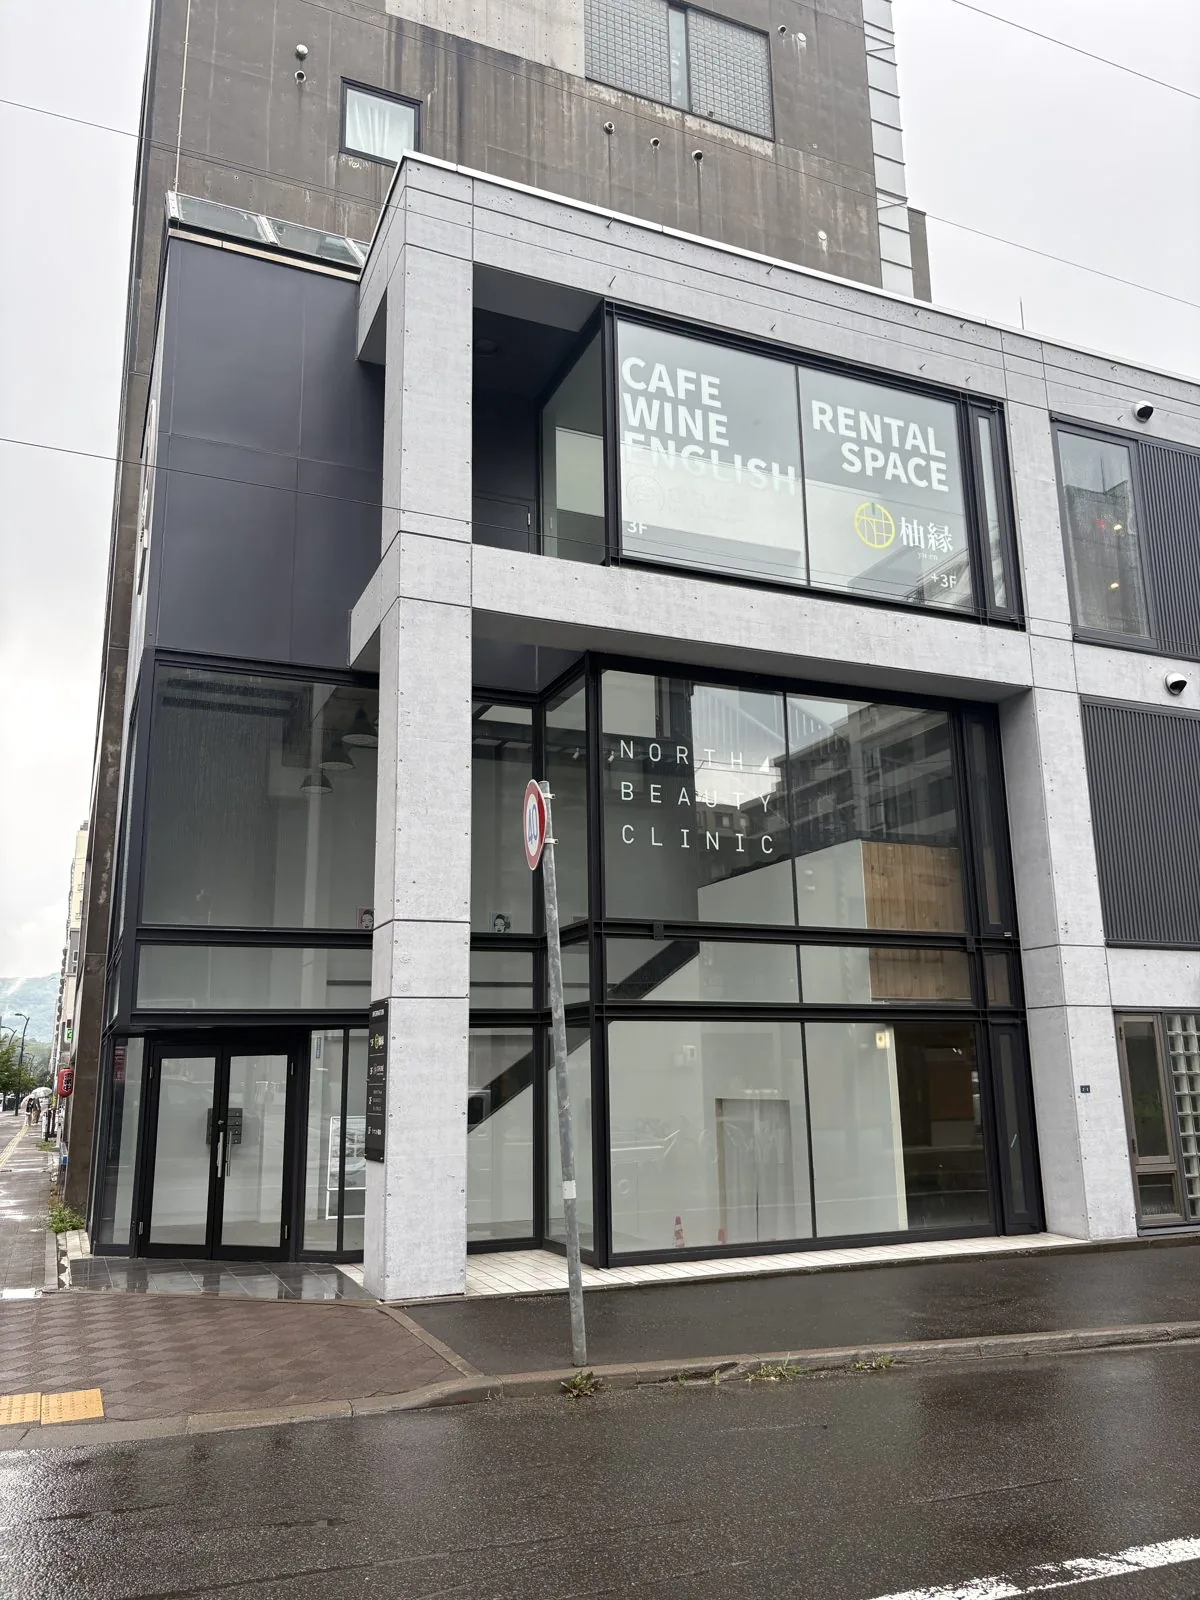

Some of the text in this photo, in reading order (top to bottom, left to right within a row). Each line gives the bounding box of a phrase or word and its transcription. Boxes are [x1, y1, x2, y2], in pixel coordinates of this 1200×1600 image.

[621, 356, 723, 409] CAFE
[622, 392, 730, 447] WINE
[811, 399, 947, 458] RENTAL
[623, 430, 797, 497] ENGLISH
[841, 442, 950, 493] SPACE
[627, 520, 648, 535] 3F
[897, 516, 954, 553] 柚縁
[620, 739, 744, 770] NORTH
[621, 781, 771, 812] BEAUTY
[528, 804, 539, 843] 40
[622, 824, 773, 854] CLINIC
